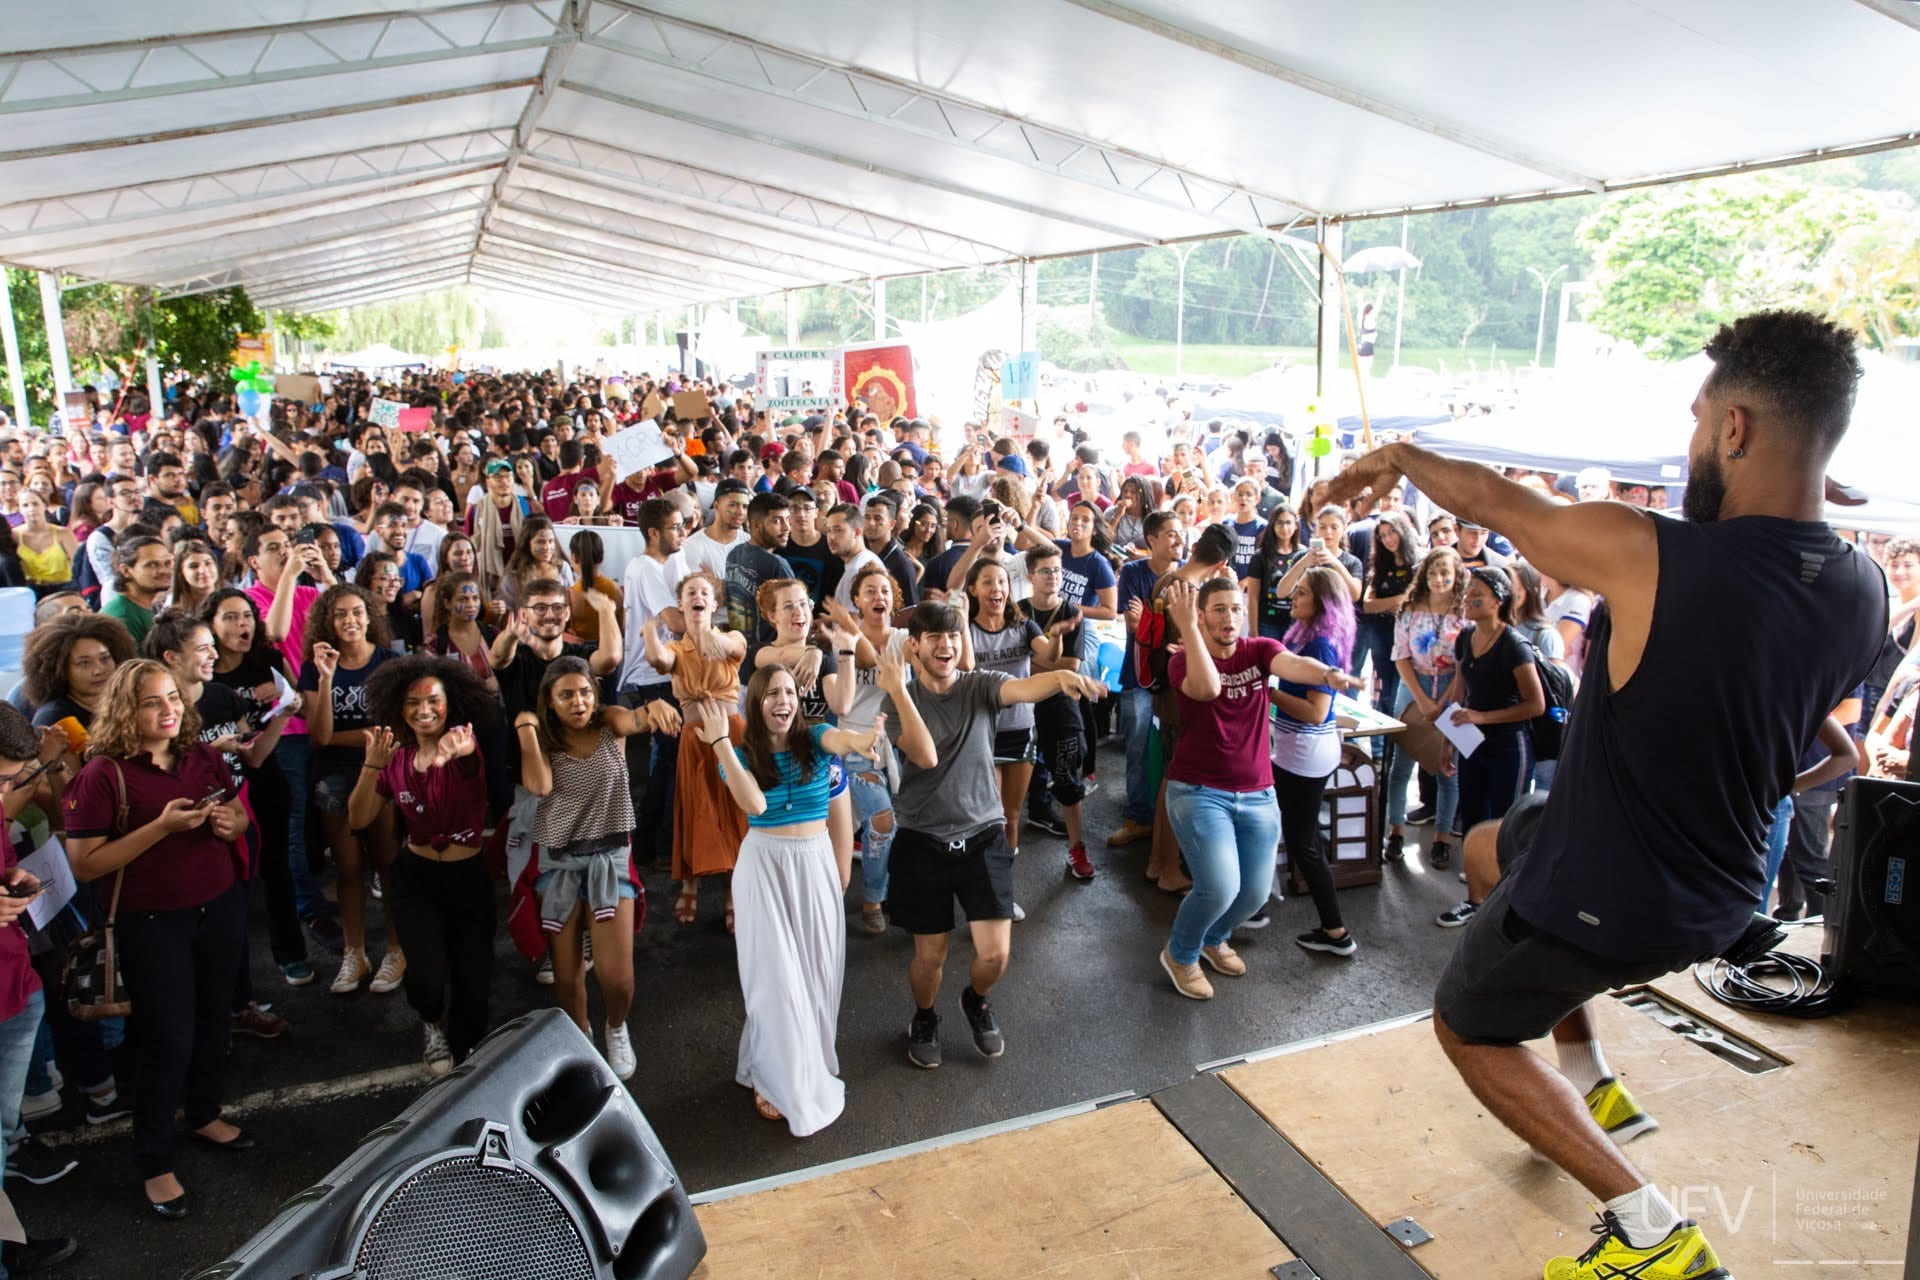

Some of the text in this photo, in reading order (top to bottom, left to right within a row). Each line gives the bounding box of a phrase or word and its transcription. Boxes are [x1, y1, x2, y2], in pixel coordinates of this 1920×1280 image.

[768, 398, 831, 408] ZOOTECNIA
[1219, 665, 1262, 687] EDICINA
[1228, 686, 1247, 699] UFV
